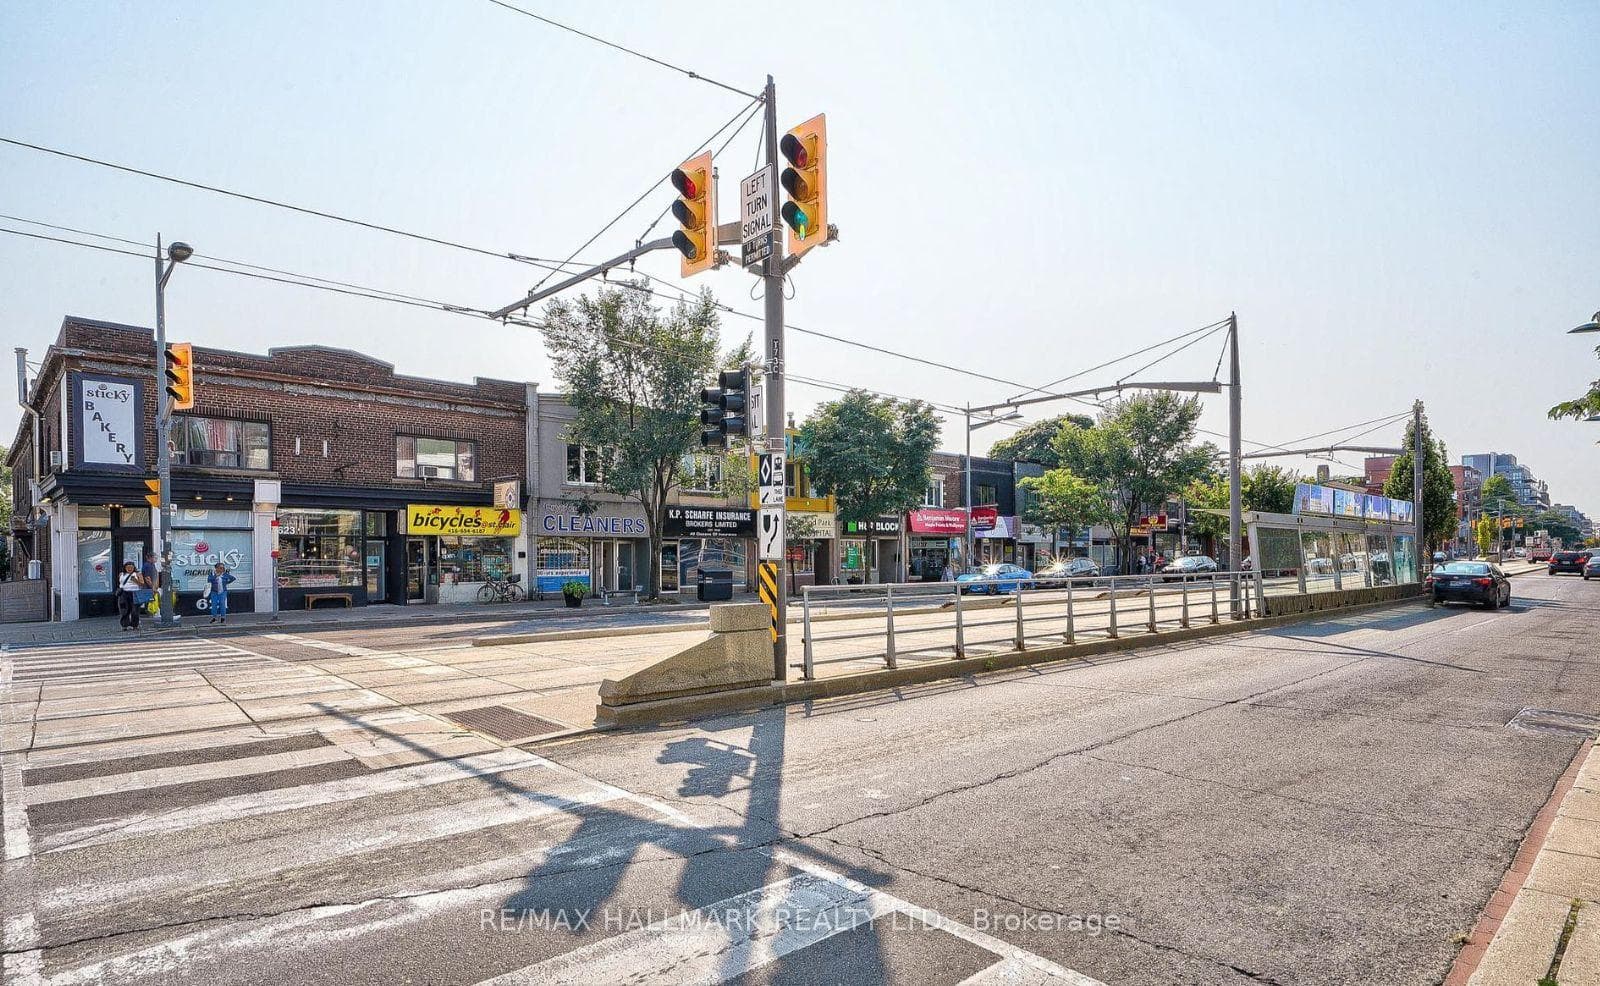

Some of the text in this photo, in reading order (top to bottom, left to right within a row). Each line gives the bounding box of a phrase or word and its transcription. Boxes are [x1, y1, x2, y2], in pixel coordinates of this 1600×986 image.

[746, 173, 766, 196] LEFT
[746, 193, 768, 216] TURN
[743, 213, 771, 239] SIGNAL
[86, 389, 130, 403] sticky
[84, 401, 133, 463] BAKERY
[413, 512, 482, 530] bicycles
[542, 514, 646, 534] CLEANERS
[669, 509, 751, 521] K.P. SCHARFE INSURANCE
[685, 520, 713, 528] BROKERS
[175, 548, 245, 570] sticky
